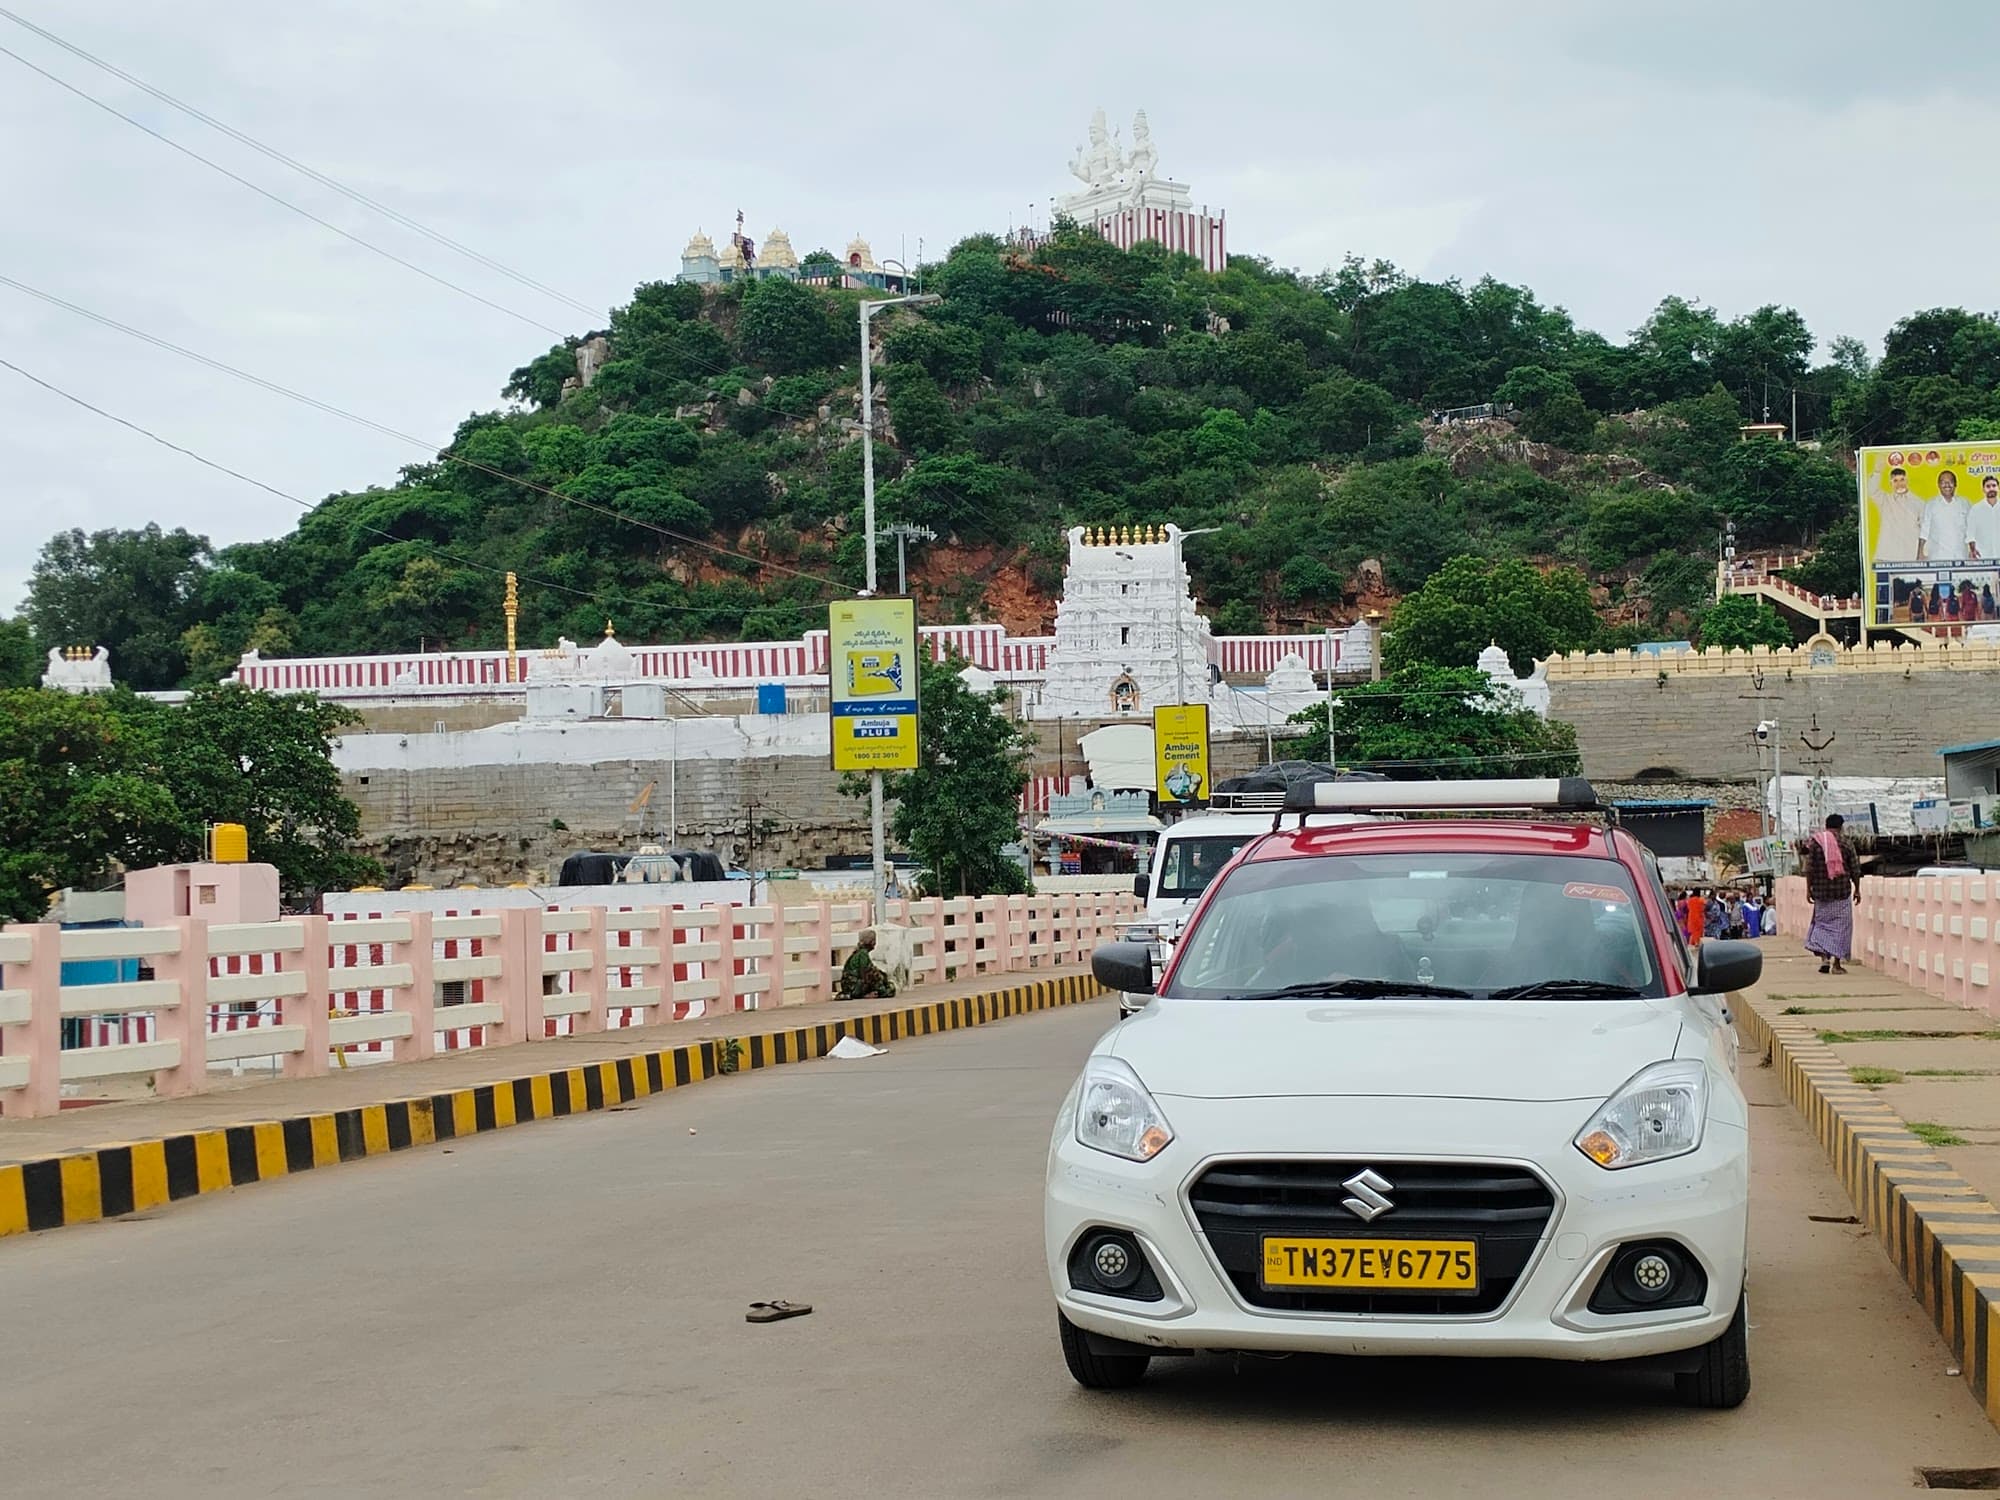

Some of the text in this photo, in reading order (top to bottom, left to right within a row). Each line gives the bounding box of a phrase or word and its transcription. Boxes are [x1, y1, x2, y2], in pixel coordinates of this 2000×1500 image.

[861, 728, 890, 736] PLUS
[1165, 743, 1200, 752] Ambuja
[1164, 752, 1200, 760] Cement
[1267, 1257, 1283, 1265] IND
[1283, 1247, 1472, 1281] TN37EV6775
